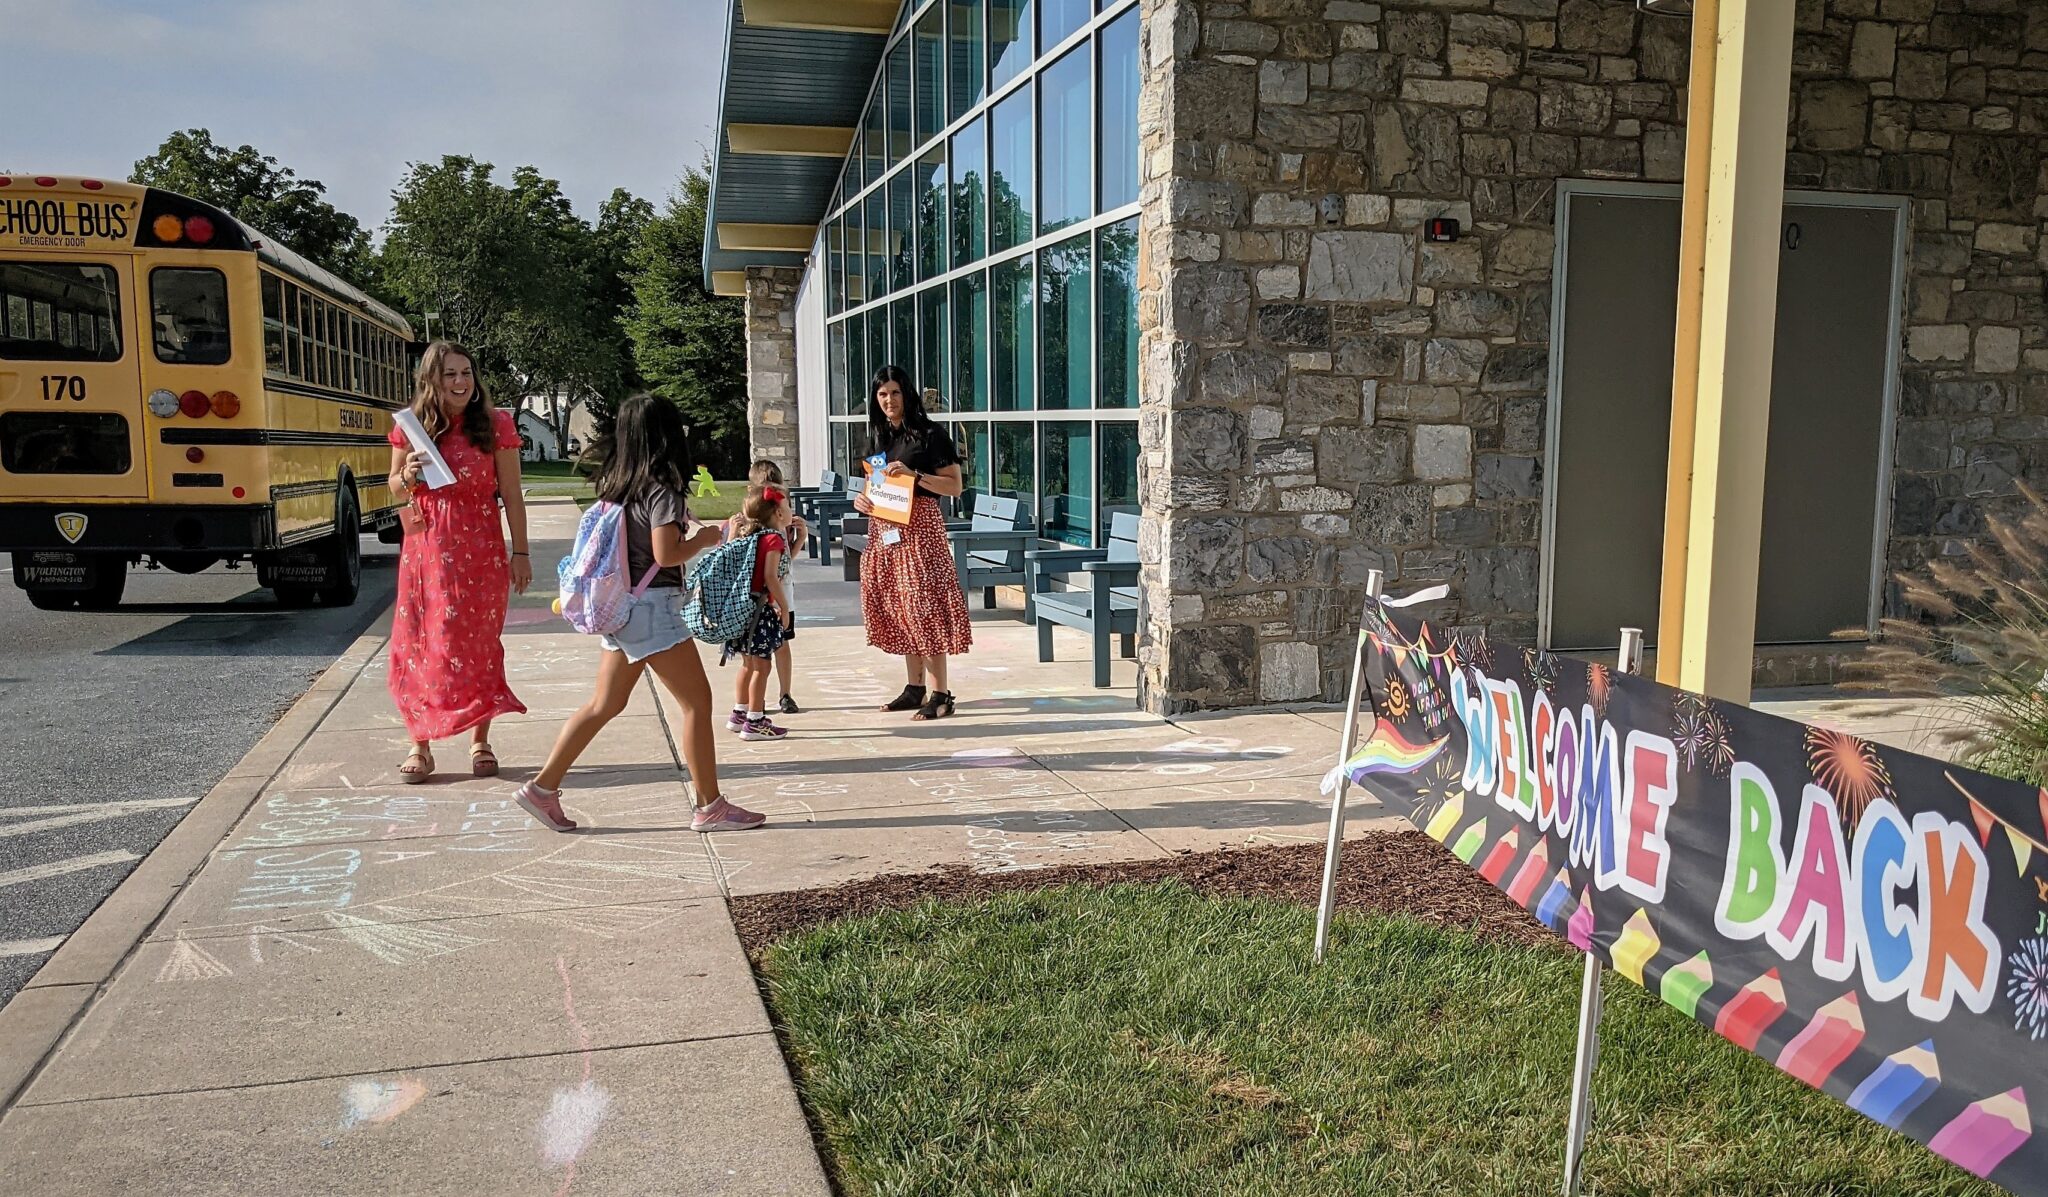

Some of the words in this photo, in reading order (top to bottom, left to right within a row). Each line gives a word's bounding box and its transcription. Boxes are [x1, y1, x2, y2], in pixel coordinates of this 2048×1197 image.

[77, 202, 128, 239] BUS
[19, 236, 63, 247] EMERGENCY
[65, 237, 86, 247] DOOR
[40, 375, 86, 402] 170
[869, 488, 909, 503] Kindergarten
[23, 567, 87, 581] WOLFINGTON
[1451, 667, 1677, 904] WELCOME
[1714, 761, 2001, 1022] BACK
[229, 848, 362, 911] START
